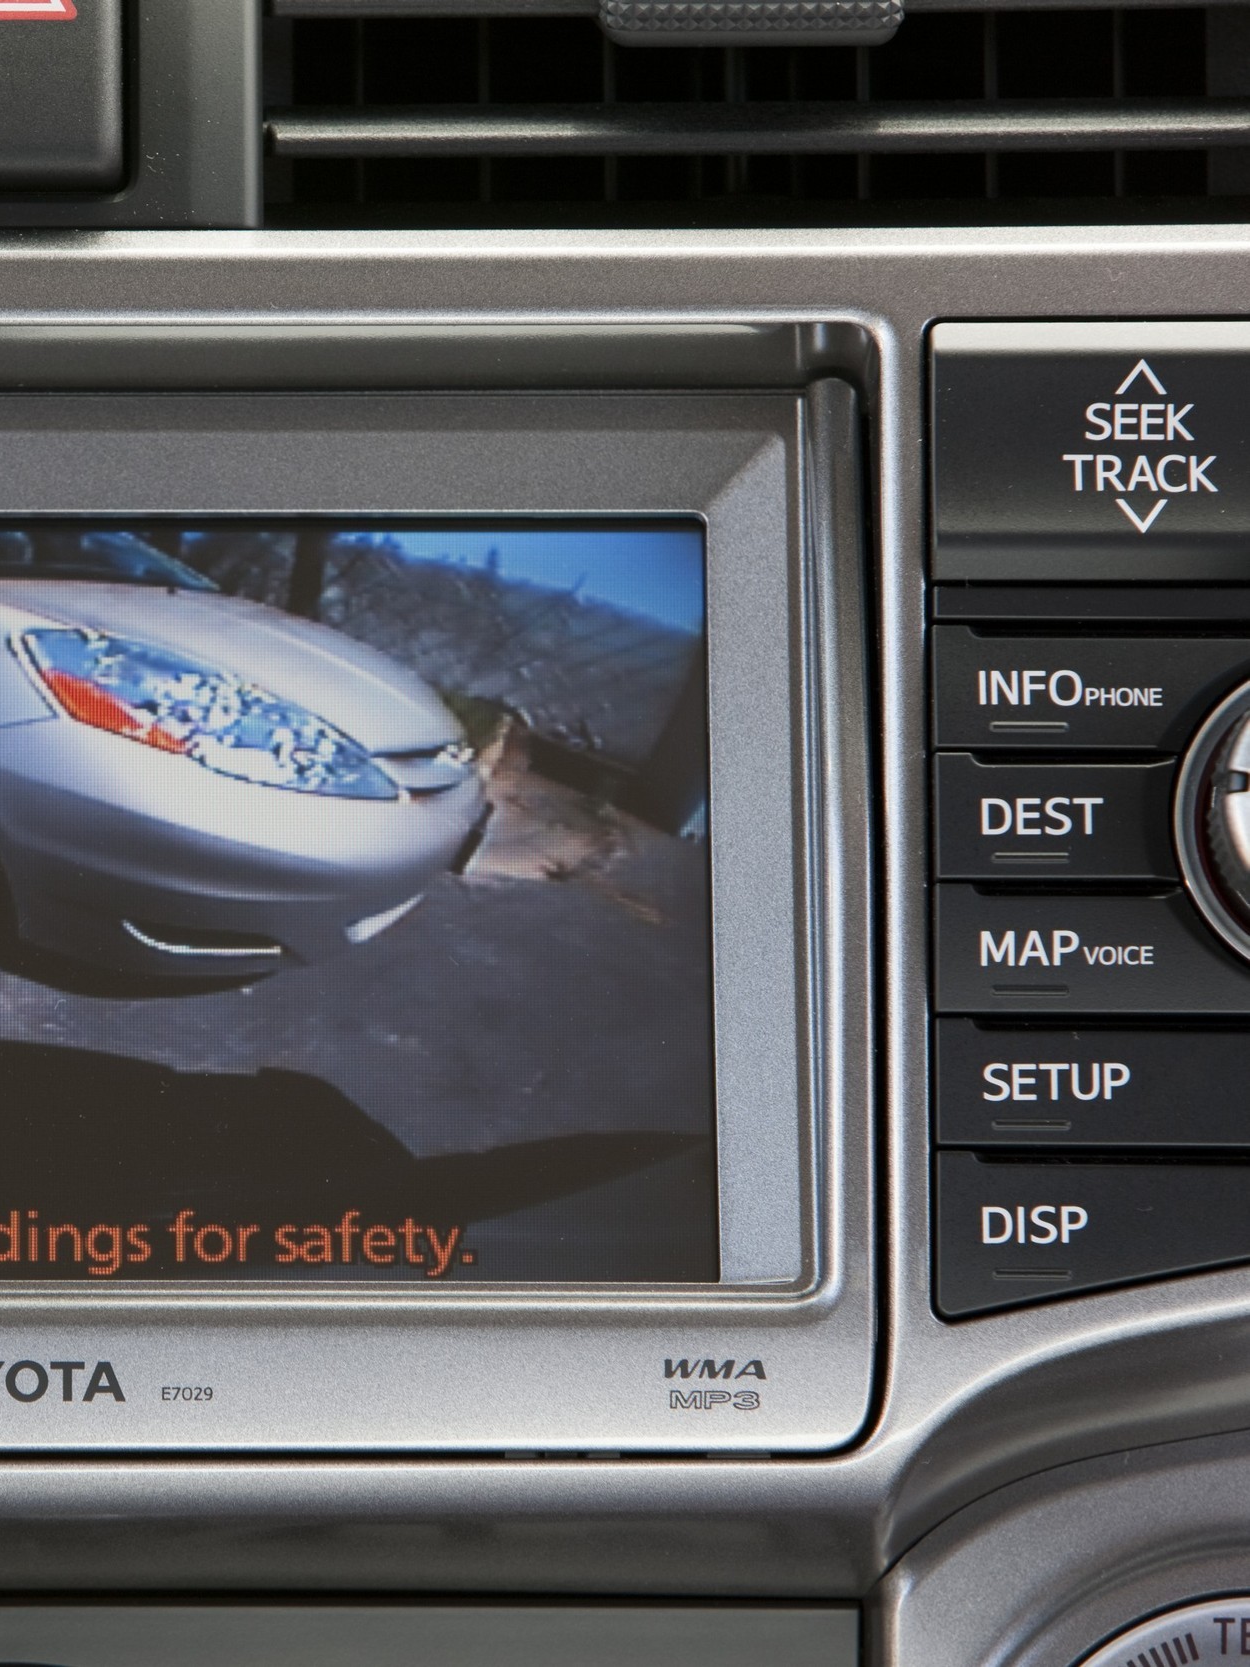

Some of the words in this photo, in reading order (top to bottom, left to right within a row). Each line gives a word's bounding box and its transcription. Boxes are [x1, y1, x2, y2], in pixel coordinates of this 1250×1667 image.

[1084, 403, 1195, 441] SEEK
[1062, 454, 1219, 493] TRACK
[977, 669, 1084, 707] INFO
[1084, 687, 1164, 706] PHONE
[980, 797, 1104, 836] DEST
[979, 930, 1080, 967] MAP
[1083, 946, 1155, 965] VOICE
[983, 1063, 1131, 1101] SETUP
[169, 1210, 257, 1263] for
[274, 1211, 476, 1277] safety.
[981, 1206, 1088, 1245] DISP
[664, 1358, 767, 1380] WMA
[161, 1387, 214, 1402] E7029
[669, 1390, 761, 1410] MP3
